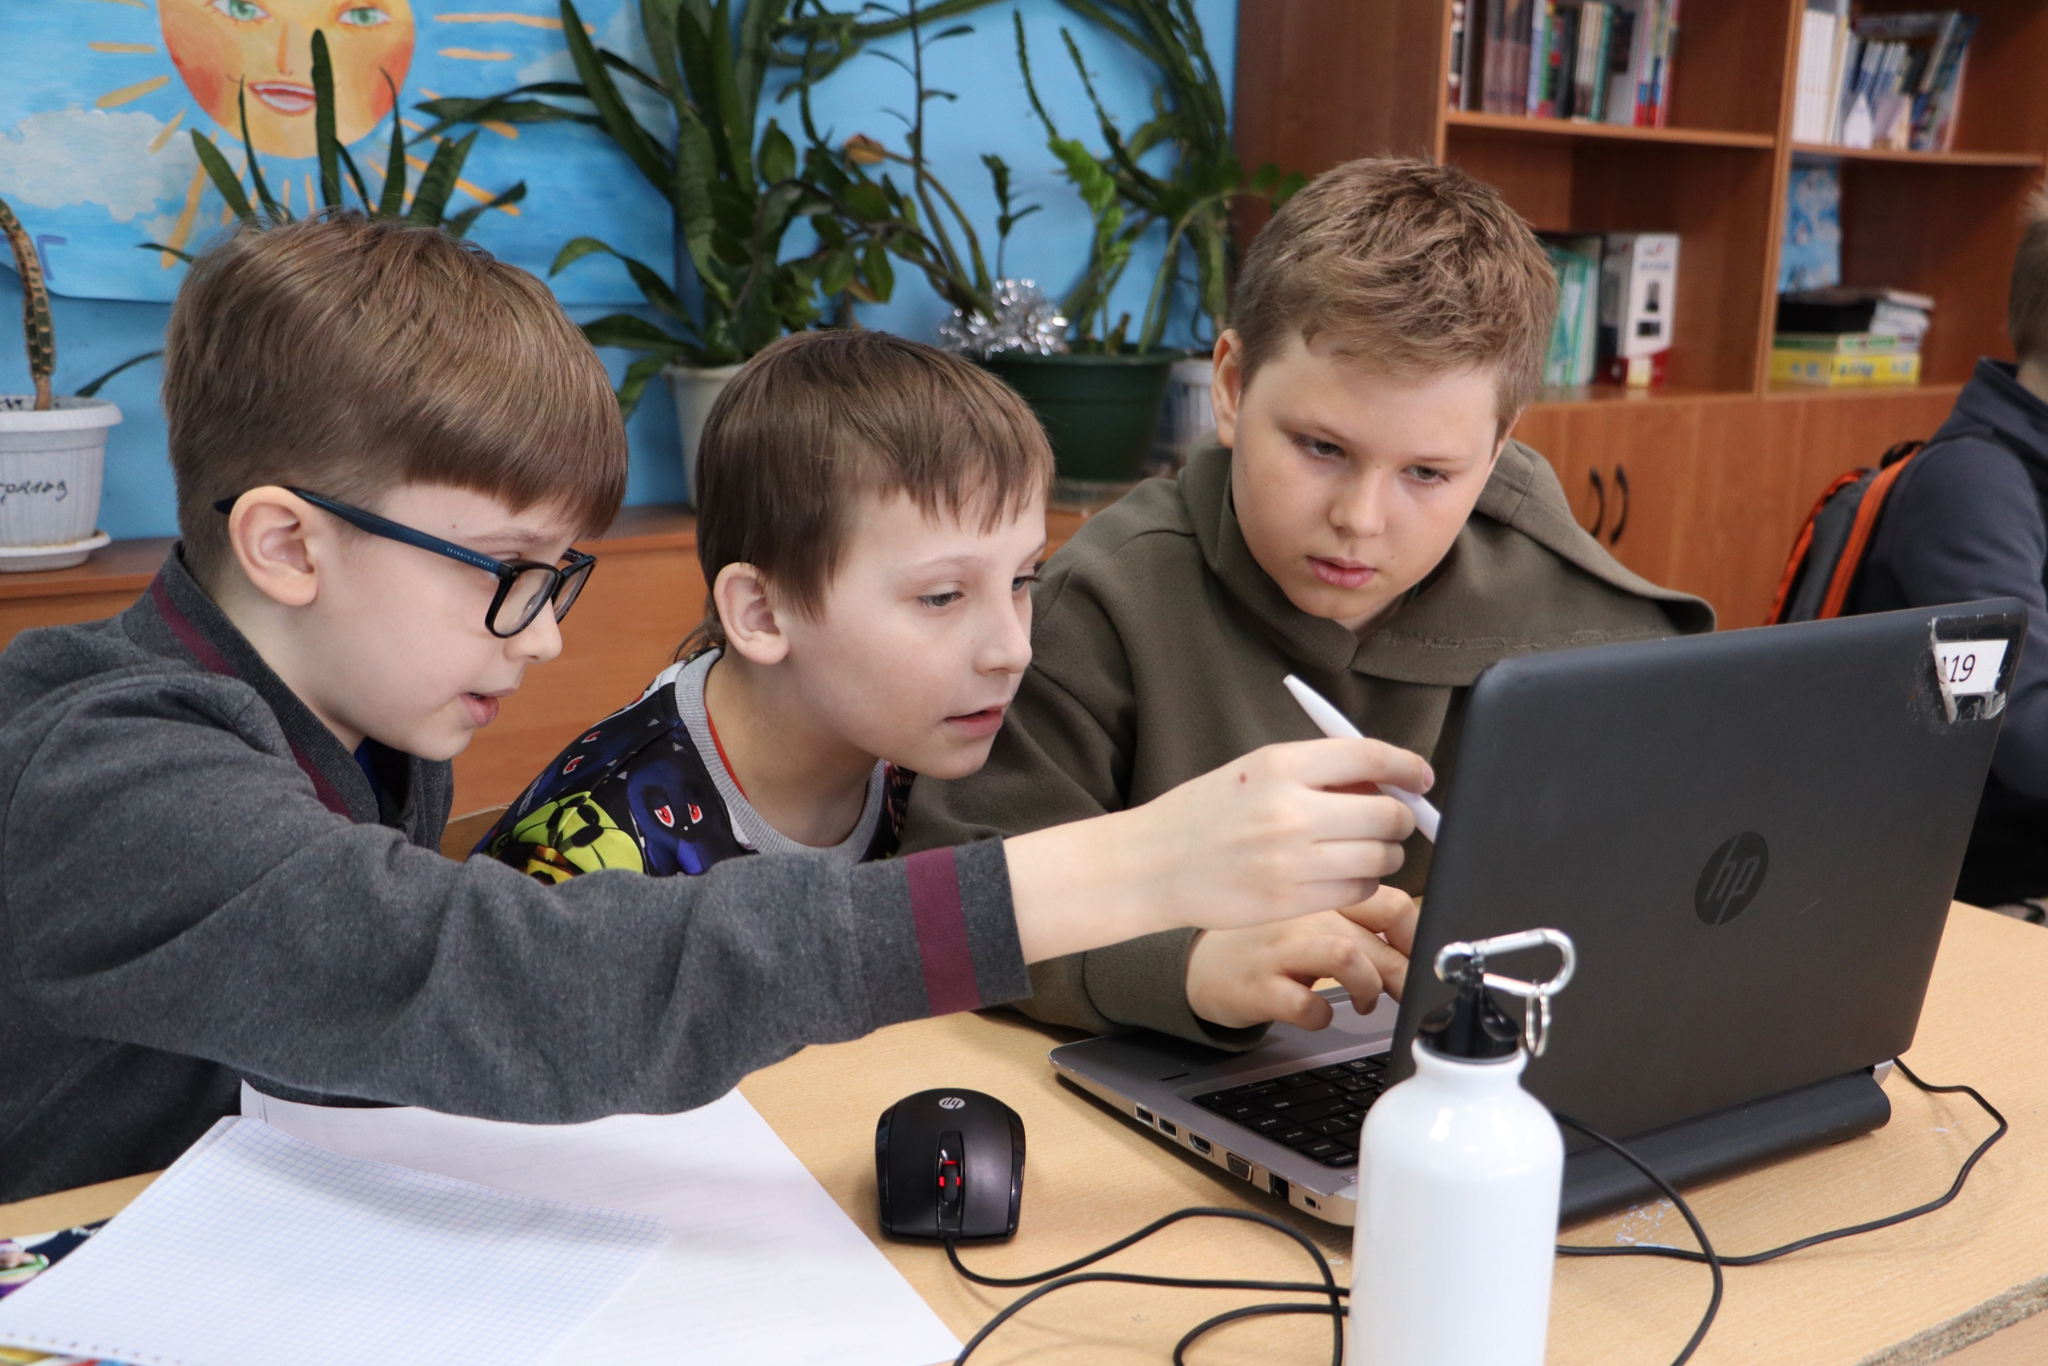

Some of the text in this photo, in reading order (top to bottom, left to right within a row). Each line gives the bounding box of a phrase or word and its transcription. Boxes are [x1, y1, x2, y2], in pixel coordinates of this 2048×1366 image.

[1942, 654, 1976, 683] 19
[1703, 836, 1762, 926] hp
[940, 1097, 962, 1110] hp
